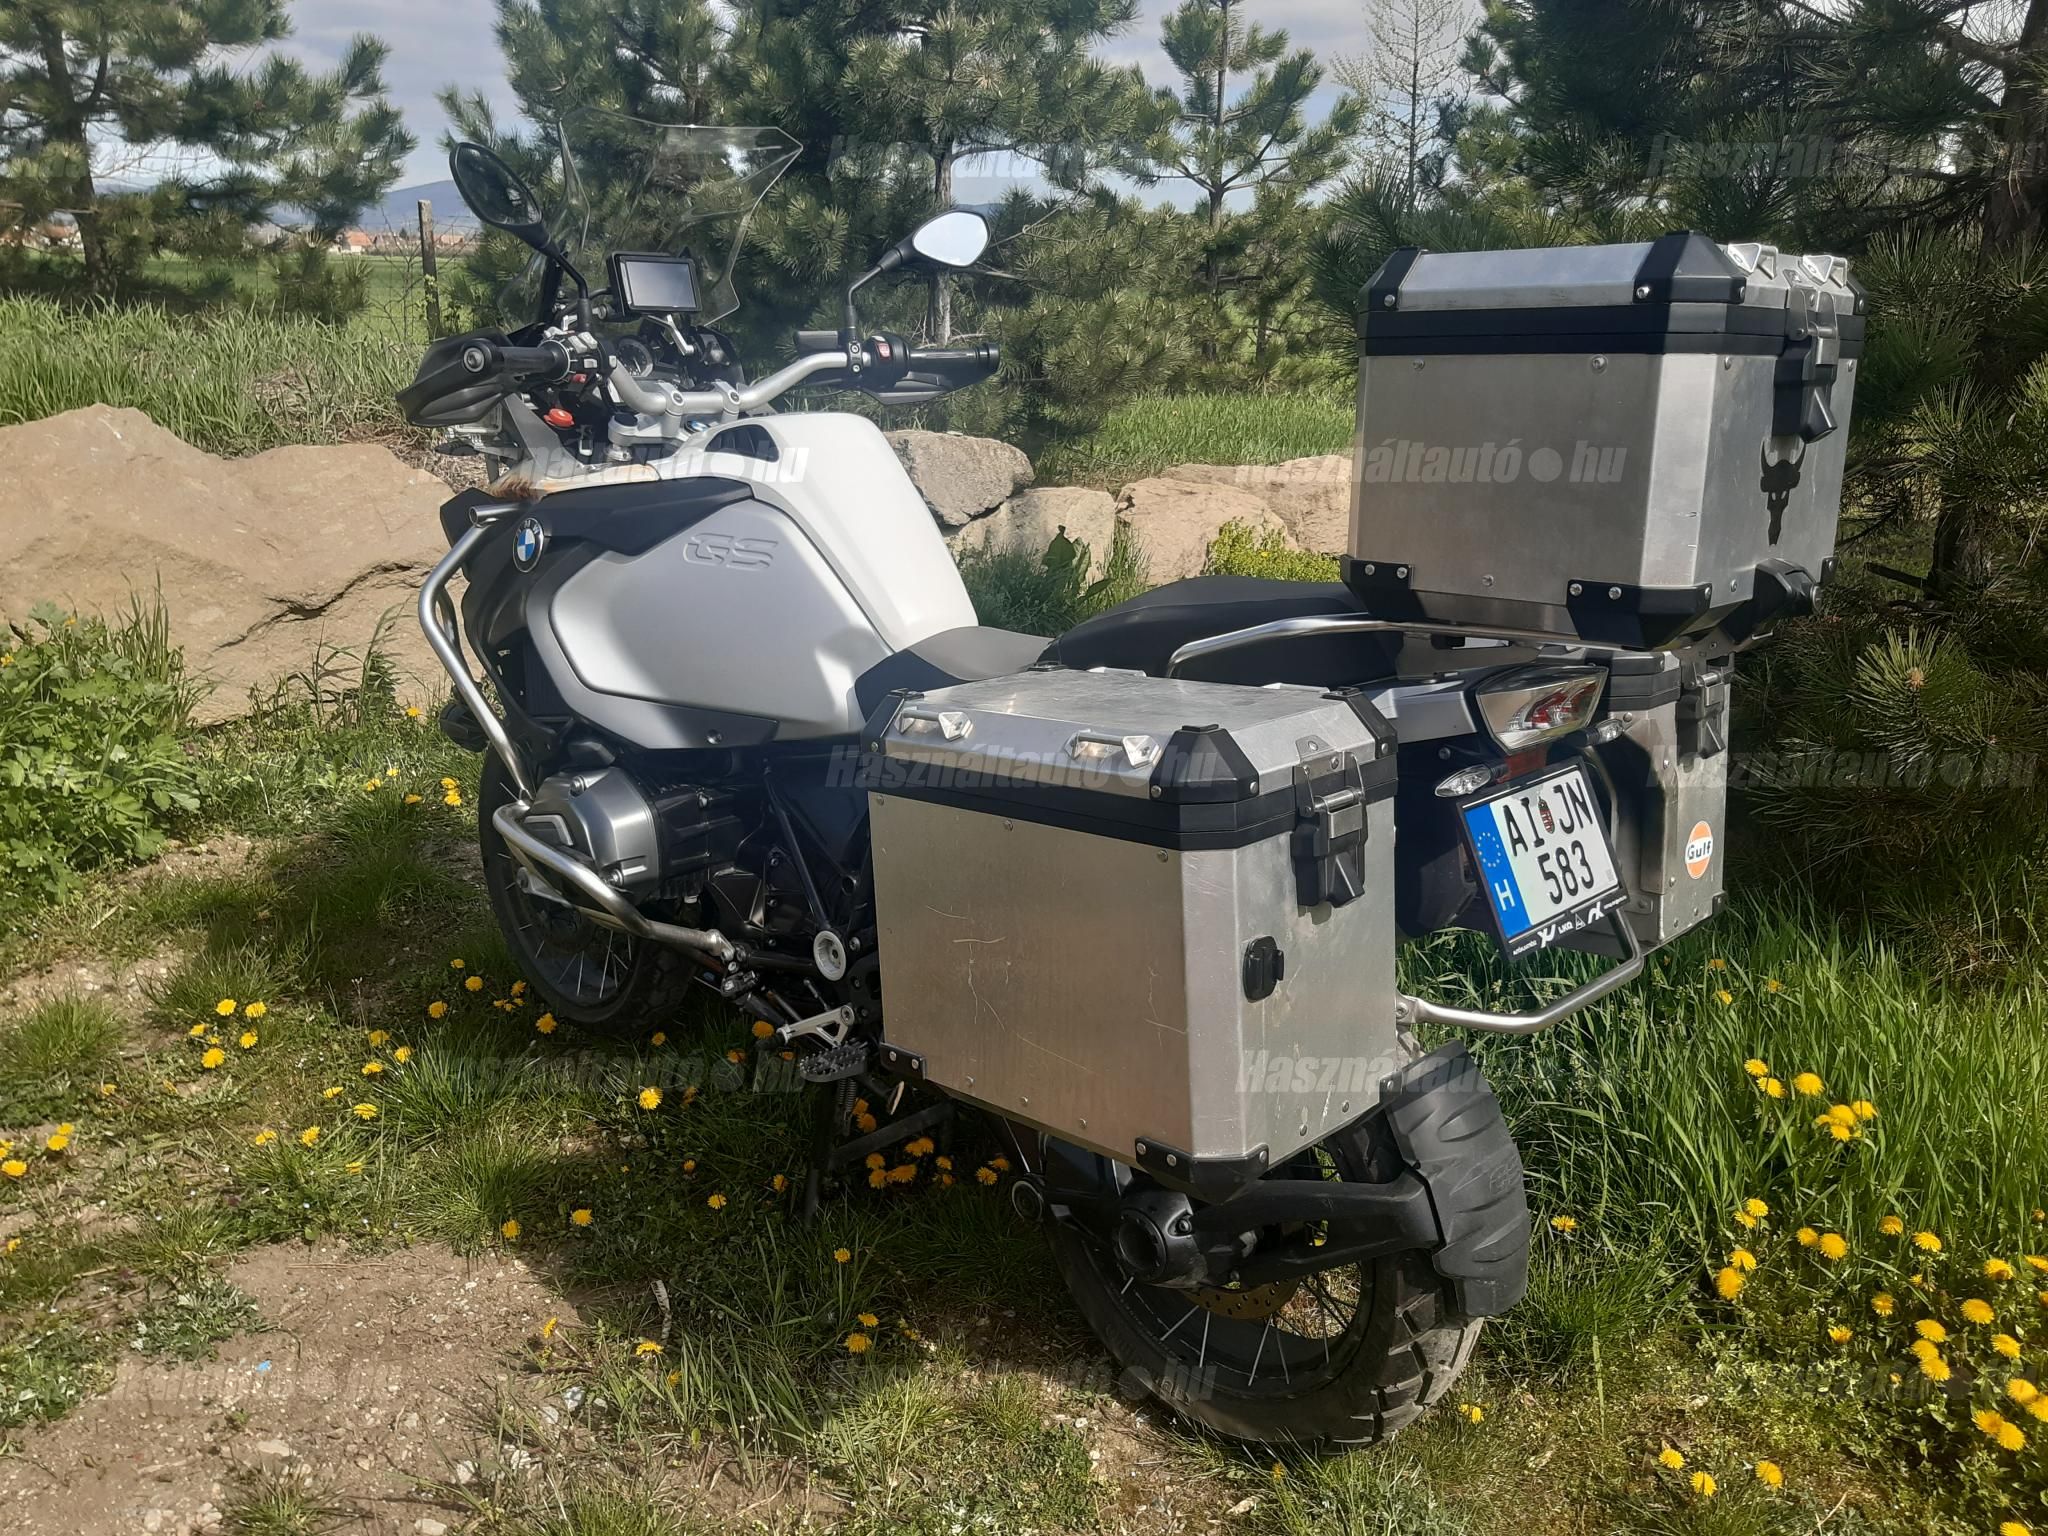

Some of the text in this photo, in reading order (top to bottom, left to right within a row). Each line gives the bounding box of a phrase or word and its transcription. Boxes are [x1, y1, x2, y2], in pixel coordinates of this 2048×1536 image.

[682, 533, 779, 571] GS
[1687, 840, 1712, 860] Gulf
[1537, 839, 1595, 905] 583
[1494, 878, 1516, 912] H
